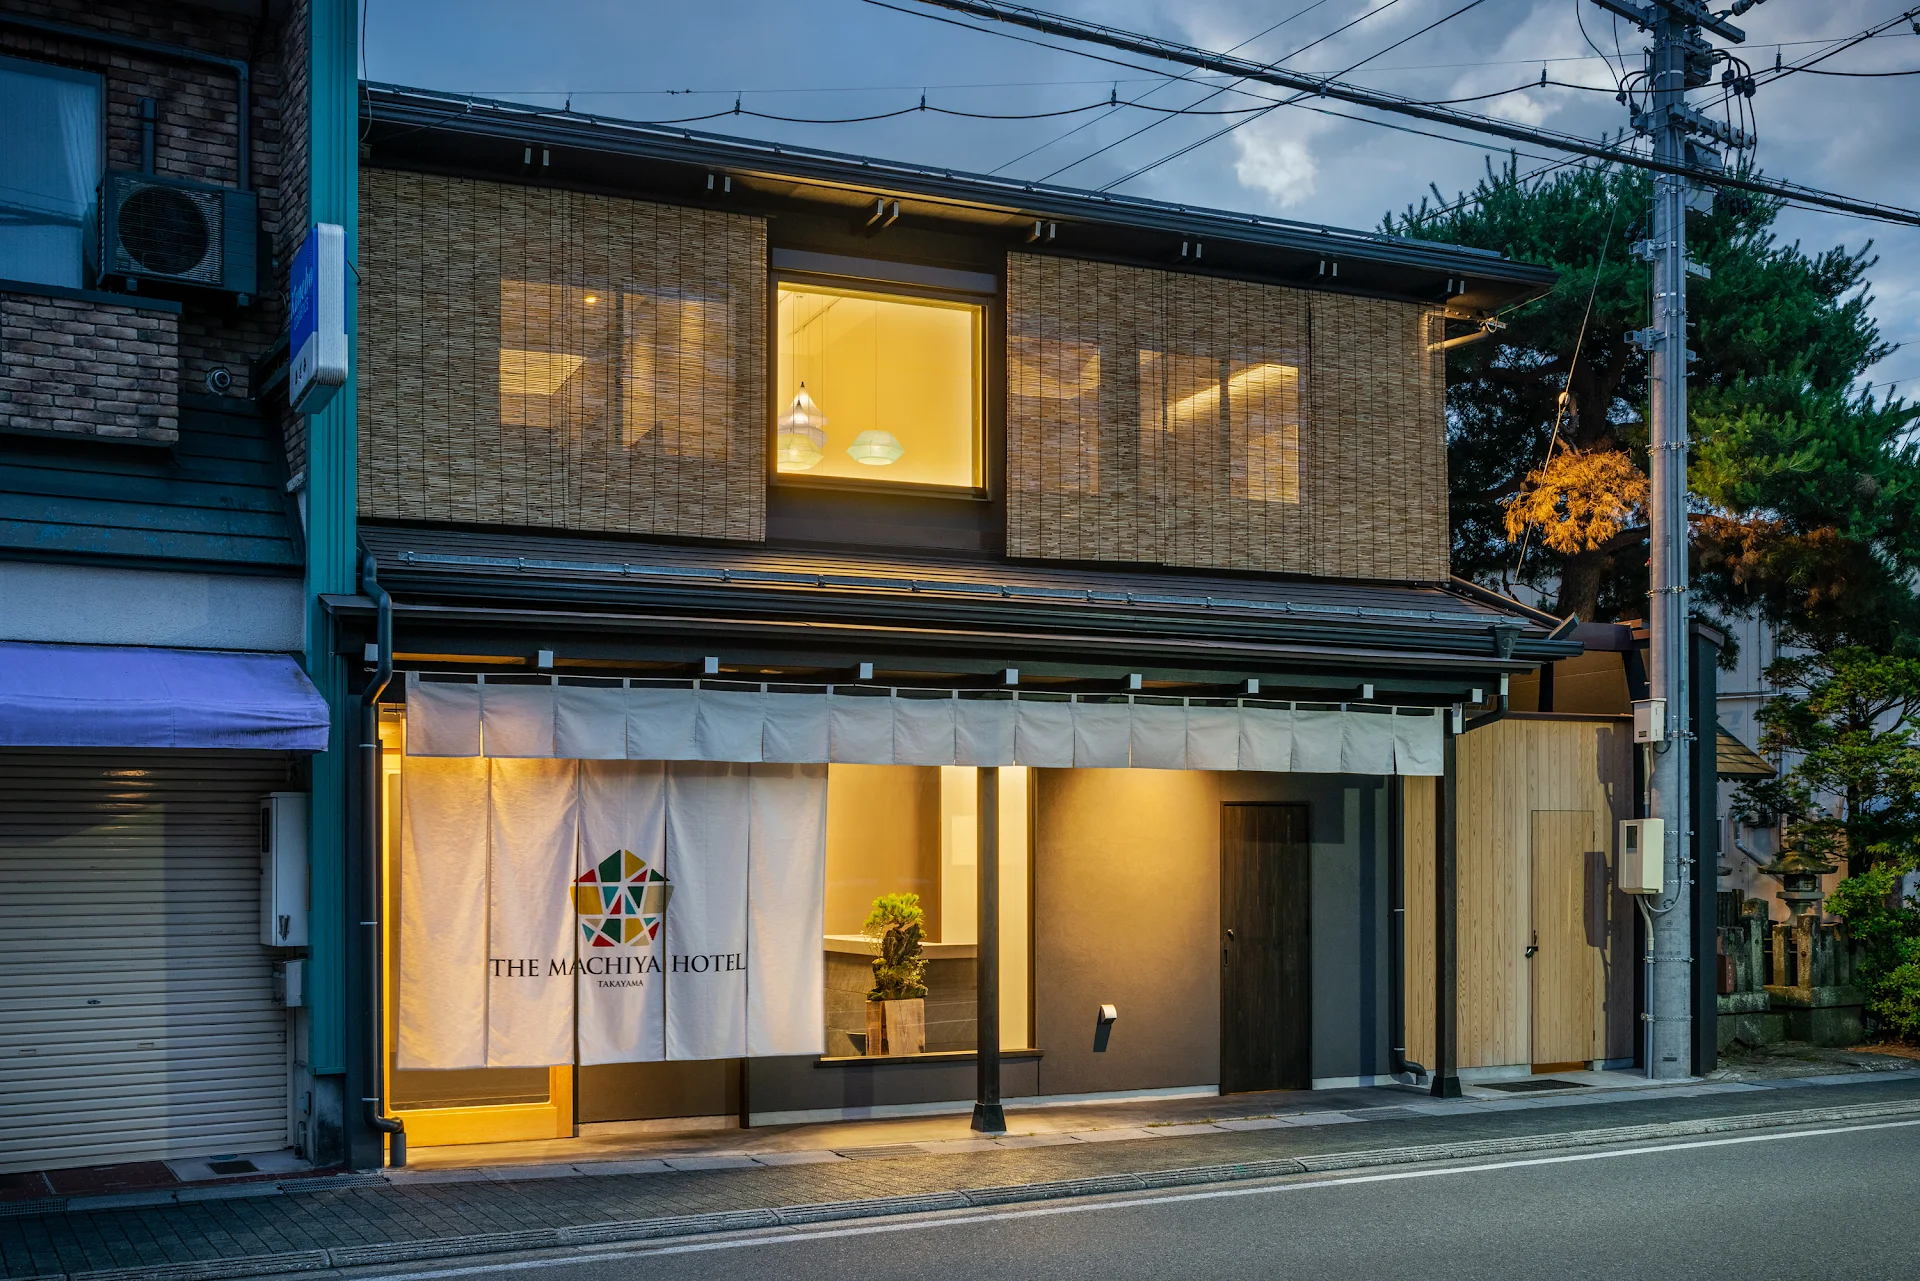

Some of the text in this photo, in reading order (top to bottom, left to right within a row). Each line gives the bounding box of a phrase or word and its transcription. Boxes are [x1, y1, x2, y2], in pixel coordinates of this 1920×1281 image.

[489, 953, 746, 977] THE MACHIYA HOTEL
[597, 979, 644, 988] TAKAYAMA
